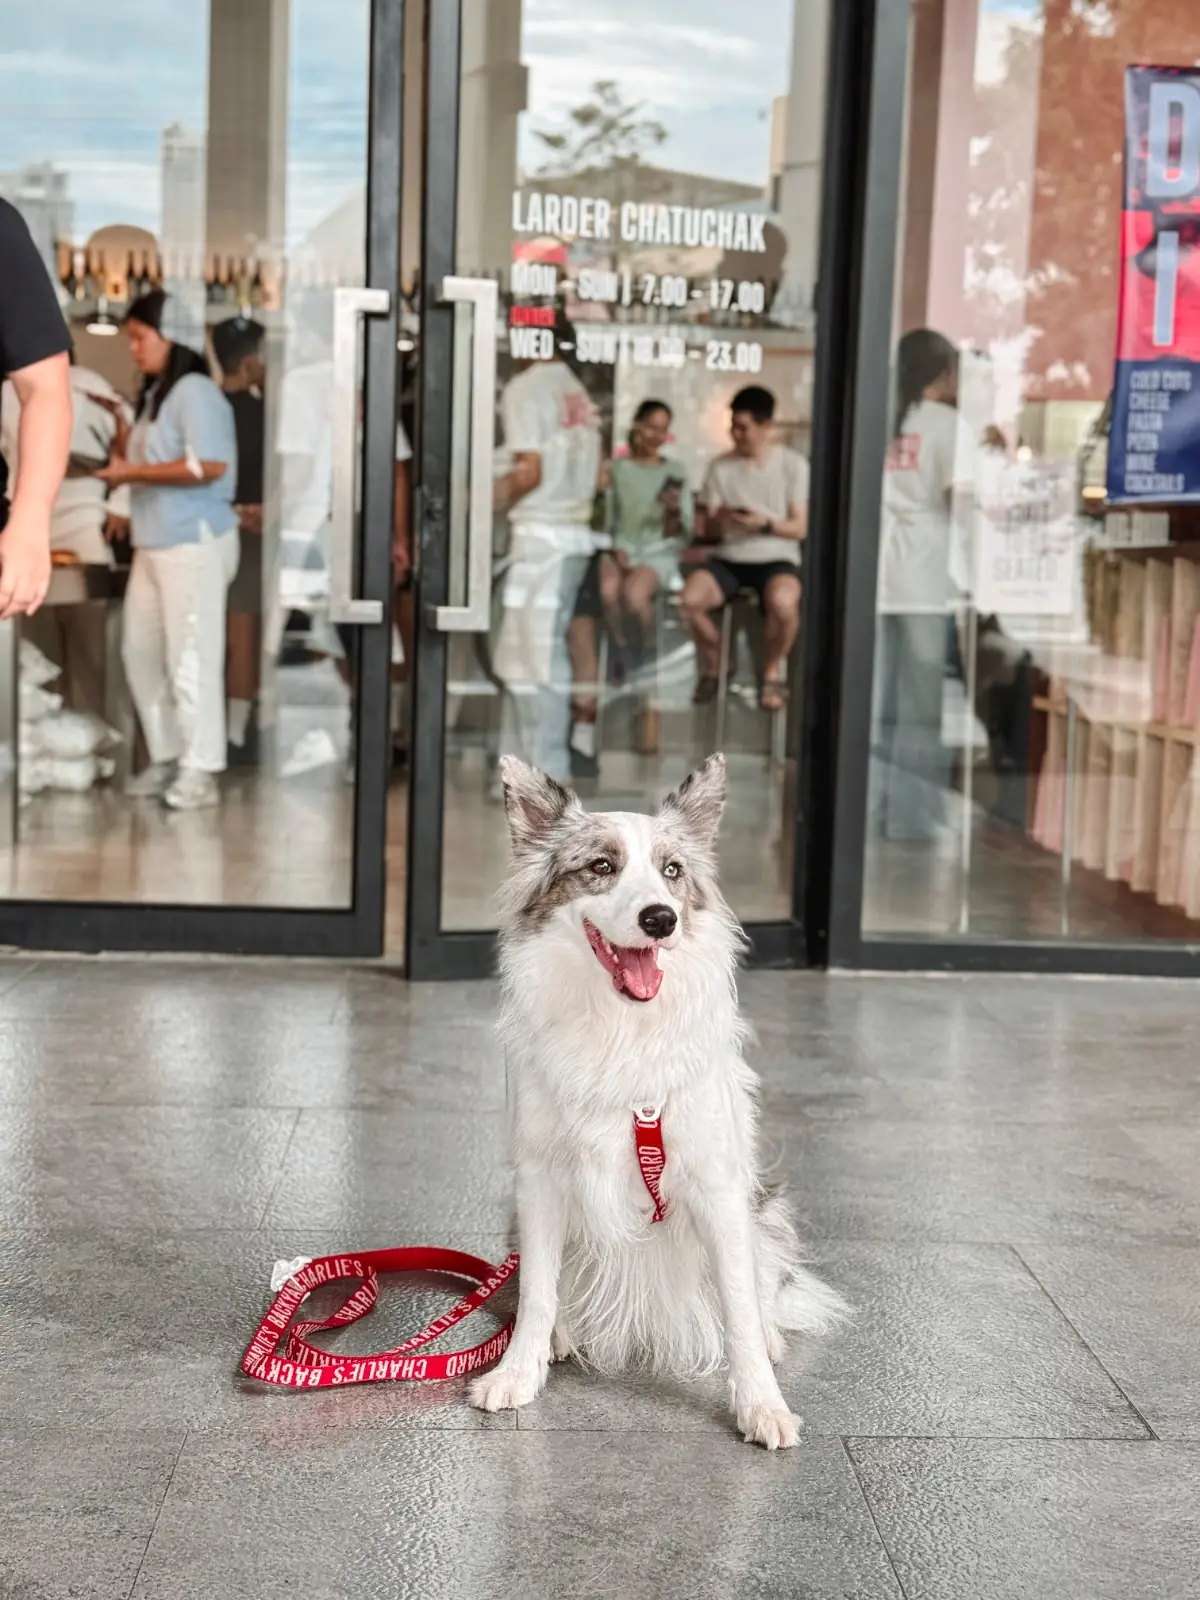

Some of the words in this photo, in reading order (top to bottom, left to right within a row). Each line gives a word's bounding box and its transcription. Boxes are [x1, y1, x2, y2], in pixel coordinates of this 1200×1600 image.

[512, 191, 611, 239] LARDER
[620, 201, 766, 252] CHATUCHAK
[510, 263, 556, 296] MON
[578, 269, 617, 302] SUN
[642, 273, 688, 307] 7.00
[710, 278, 765, 313] 17.00
[510, 328, 554, 360] WED
[706, 339, 762, 373] 23.00
[477, 1251, 520, 1298] BACK
[331, 1359, 428, 1384] CHARLIE'S
